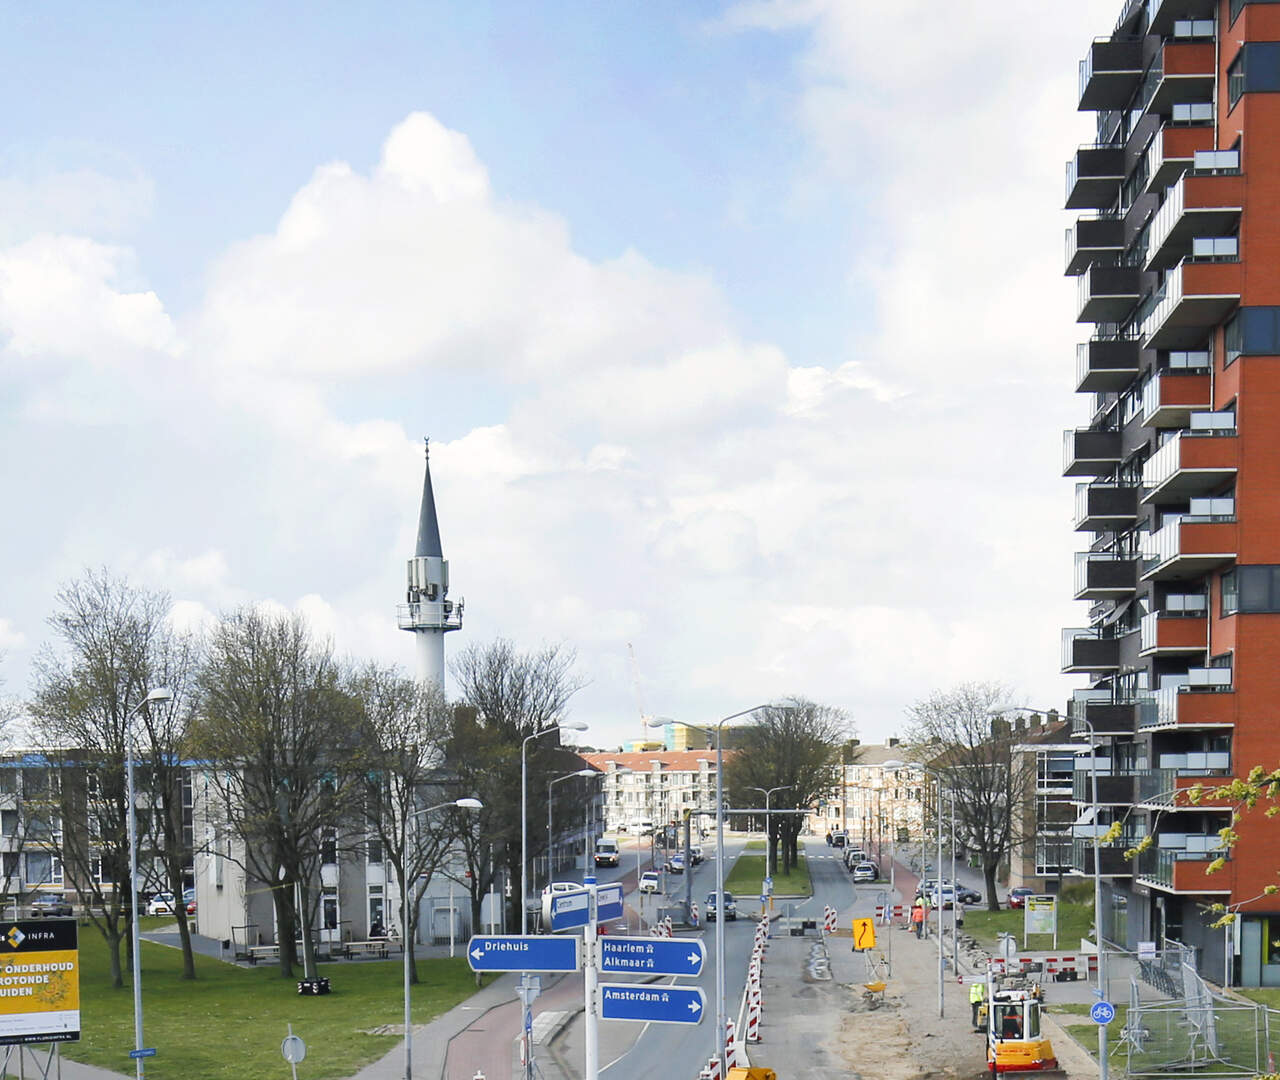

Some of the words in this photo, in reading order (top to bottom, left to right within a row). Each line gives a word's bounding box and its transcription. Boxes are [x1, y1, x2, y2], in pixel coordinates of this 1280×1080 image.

[28, 931, 55, 940] INFRA
[485, 941, 529, 951] Driehuis
[604, 943, 645, 953] Haarlem
[604, 956, 645, 967] Alkmaar
[5, 962, 74, 974] ONDERHOUD
[604, 990, 660, 1002] Amsterdam
